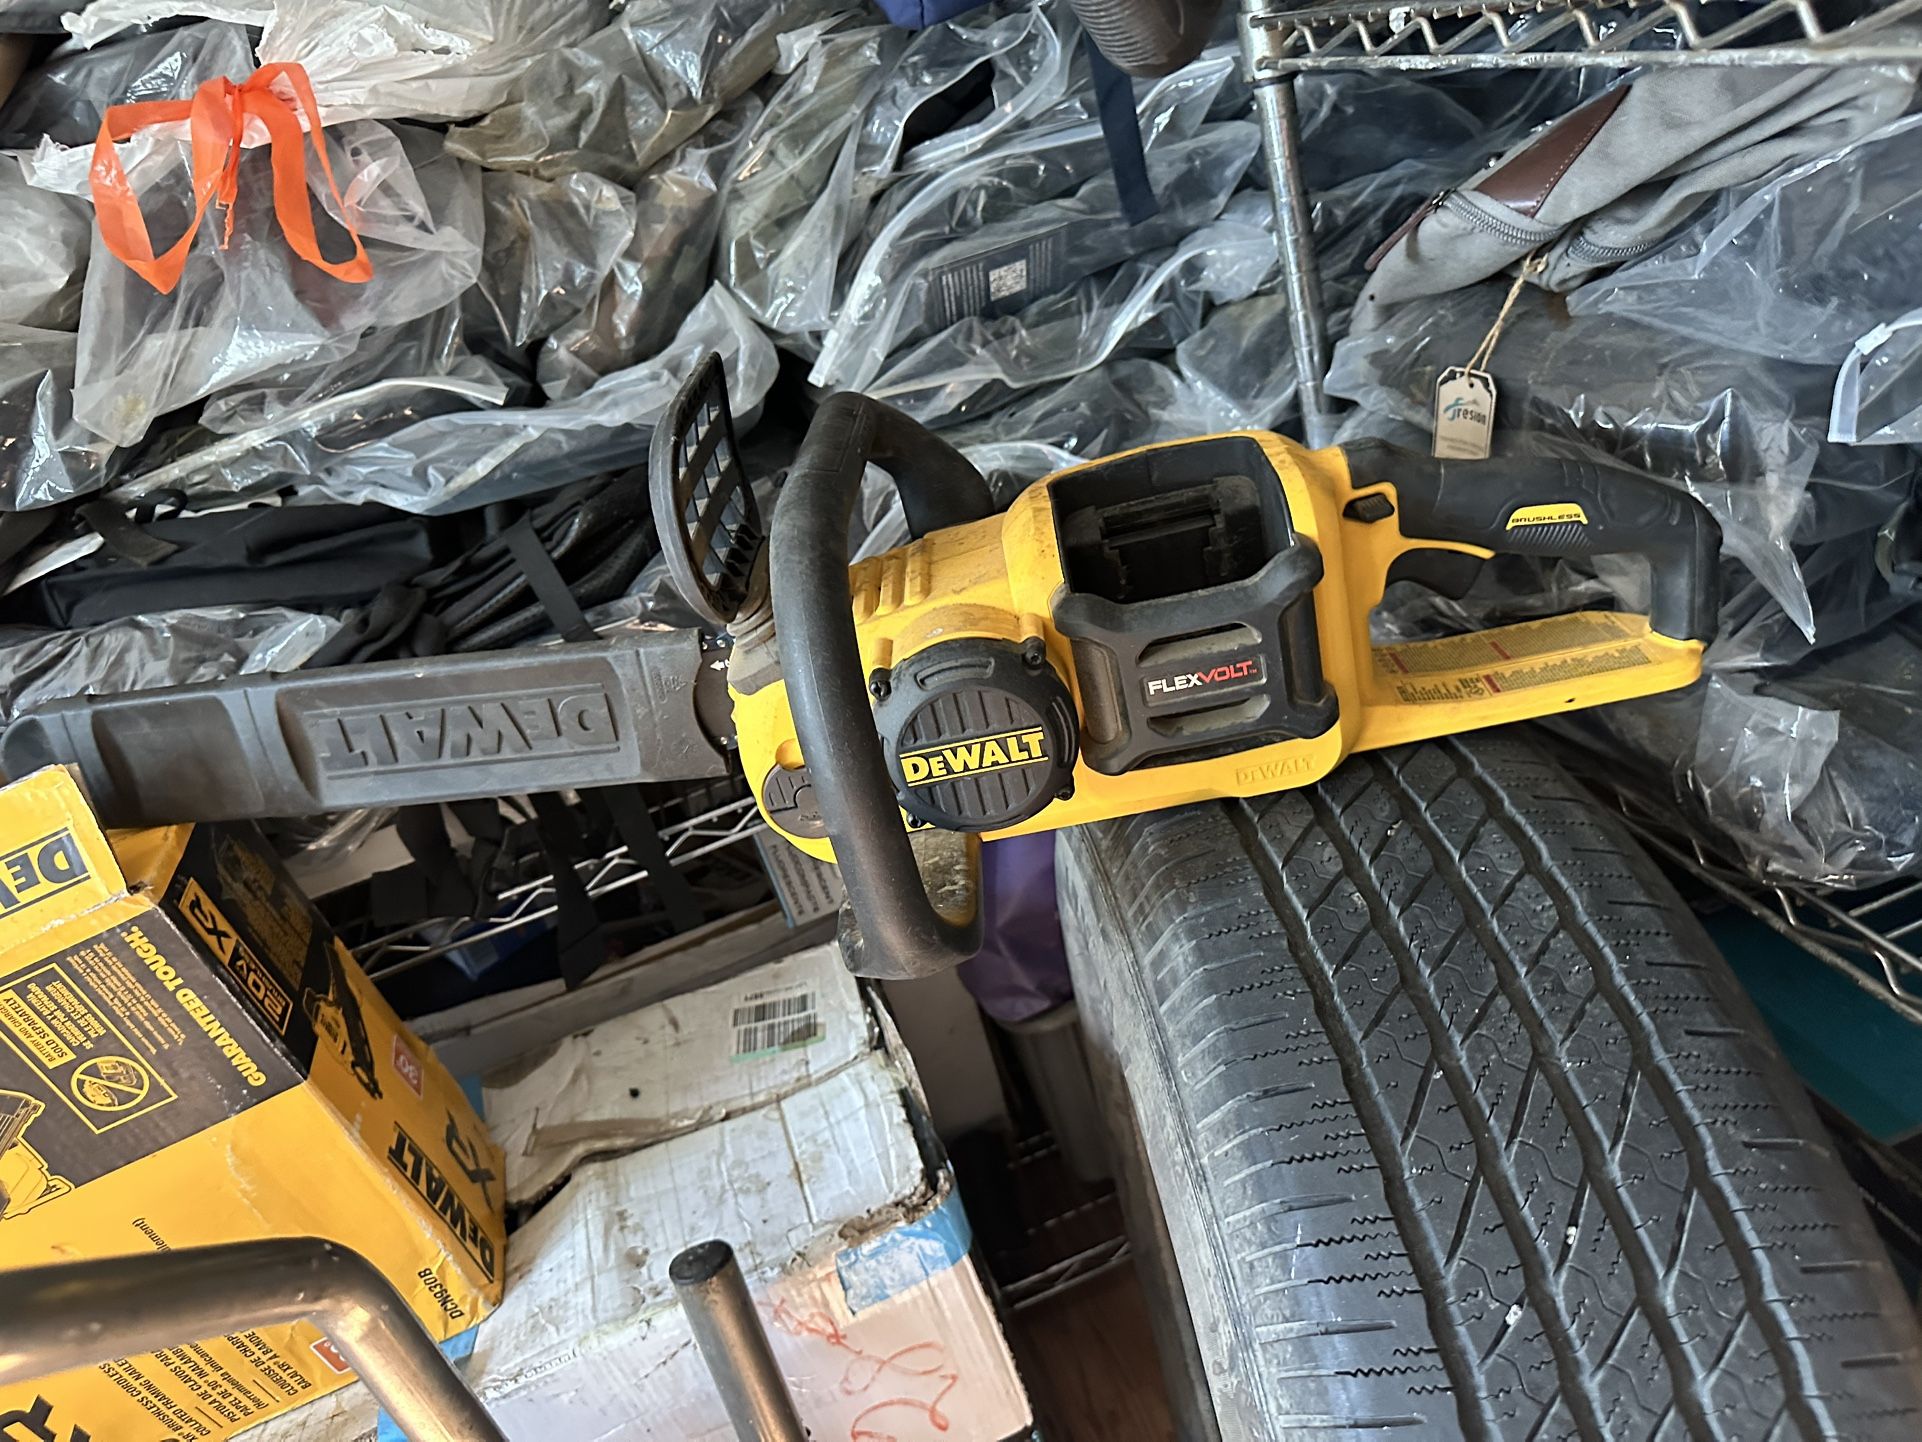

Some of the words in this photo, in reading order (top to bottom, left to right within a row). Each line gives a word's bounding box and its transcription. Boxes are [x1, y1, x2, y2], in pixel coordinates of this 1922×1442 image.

[1511, 513, 1580, 522] BRUSHLESS
[0, 1003, 21, 1027] CHARGE
[3, 995, 48, 1039] SEPARATELY
[17, 1025, 34, 1039] AND
[172, 984, 268, 1086] GUARANTEED
[29, 1037, 56, 1062] BATTERY
[43, 1037, 67, 1058] SOLD
[416, 1266, 464, 1319] DCN930B
[223, 1330, 256, 1358] CHARP
[243, 1331, 273, 1354] BANDE
[186, 1341, 223, 1372] únicame
[249, 1355, 265, 1366] DE
[99, 1361, 141, 1397] CORDLESS
[170, 1365, 202, 1391] CLAVOS
[220, 1371, 269, 1409] (Herramienta
[259, 1365, 298, 1396] CLOUEUSE
[286, 1370, 311, 1389] BALAI
[140, 1378, 177, 1409] FRAMING
[196, 1389, 212, 1399] DE
[217, 1388, 232, 1399] DE
[137, 1395, 183, 1432] BRUSHLESS
[207, 1398, 240, 1422] PISTOLA
[227, 1397, 254, 1416] PAPEL
[173, 1407, 210, 1436] COLLATED
